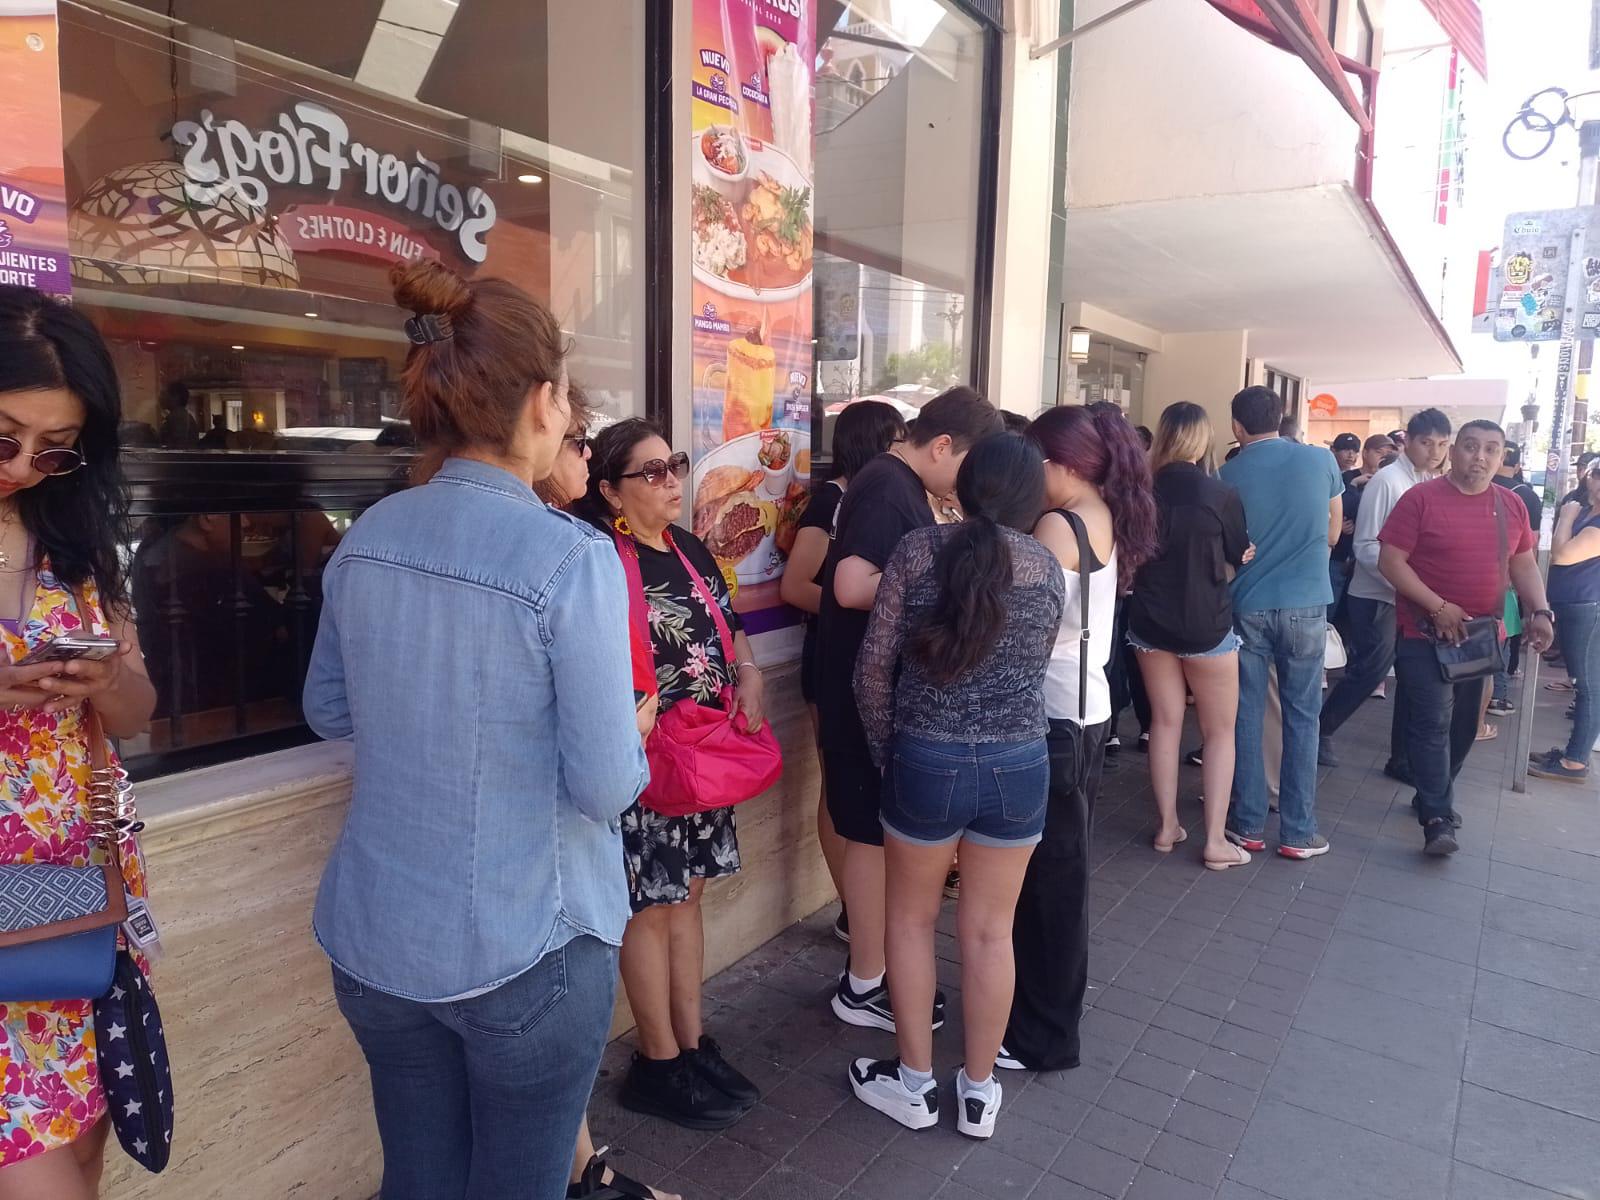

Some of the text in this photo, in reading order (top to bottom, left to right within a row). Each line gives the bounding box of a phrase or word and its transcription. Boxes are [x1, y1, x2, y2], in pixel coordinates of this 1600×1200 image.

[701, 51, 730, 75] NUEVO
[696, 86, 703, 96] LA
[694, 318, 713, 330] MANGO
